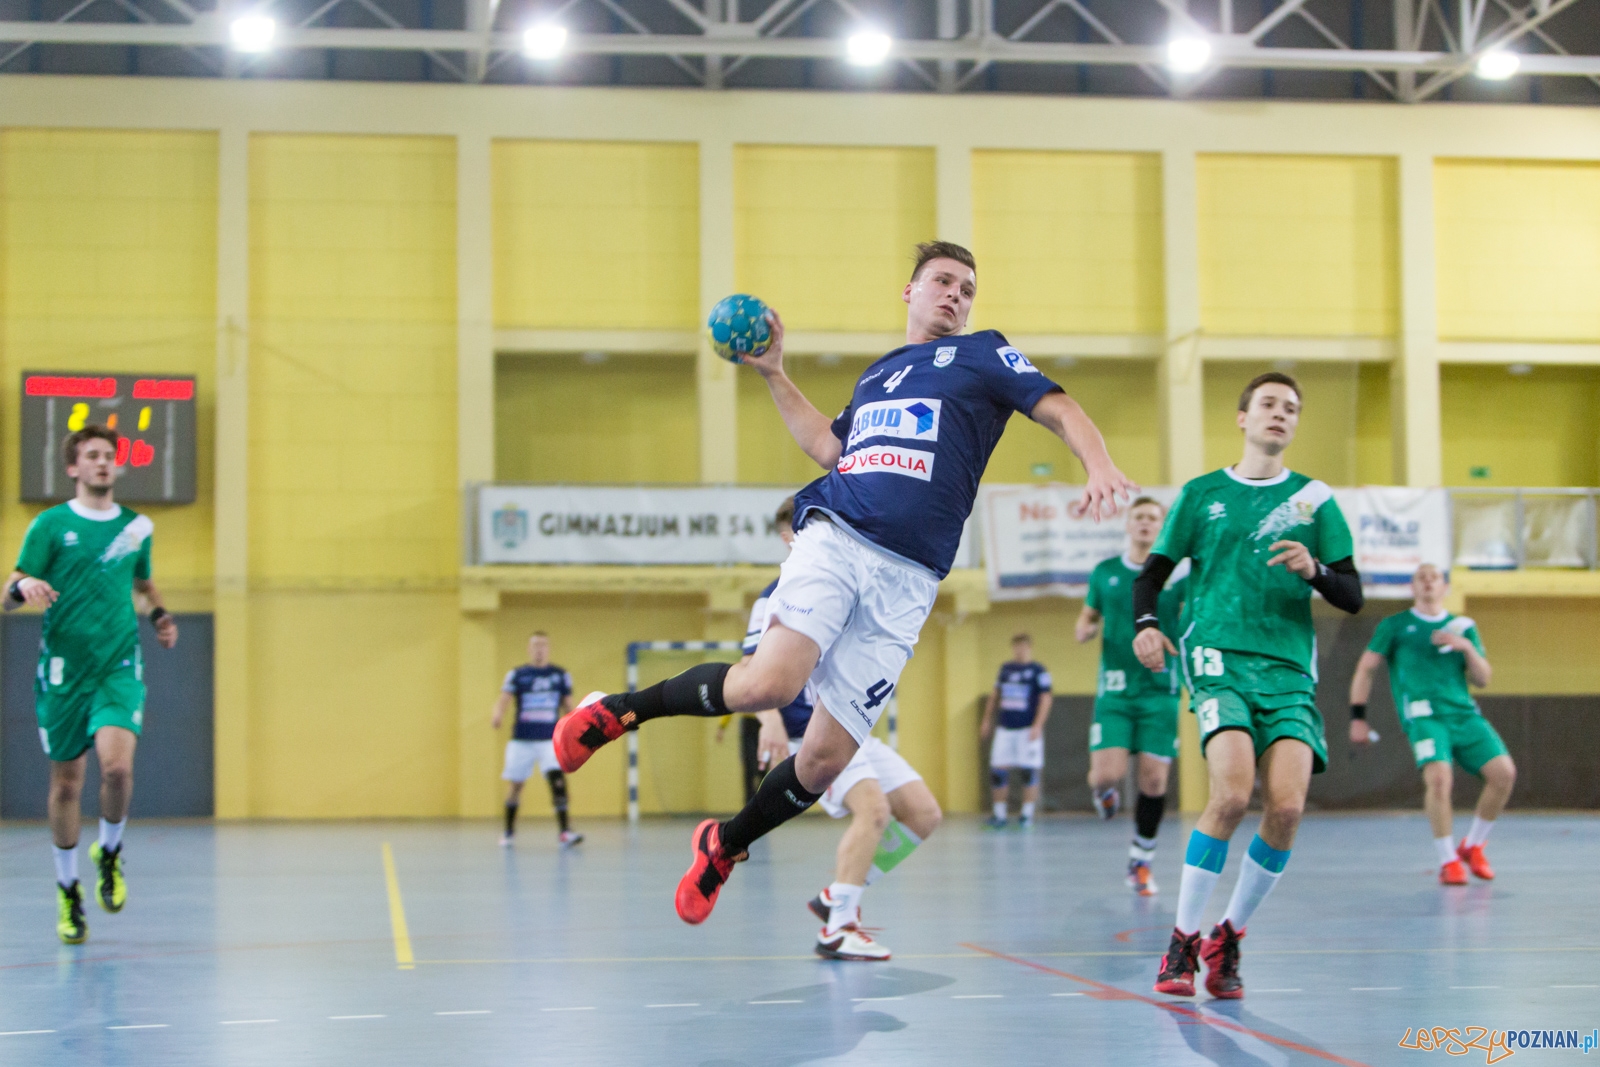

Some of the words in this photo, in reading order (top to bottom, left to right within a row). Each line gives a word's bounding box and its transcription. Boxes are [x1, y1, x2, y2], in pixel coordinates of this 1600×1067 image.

[882, 364, 914, 393] 4
[859, 452, 927, 474] VEOLIA
[539, 512, 680, 537] GIMNAZJUM
[688, 513, 719, 536] NR
[1191, 645, 1225, 676] 13
[862, 677, 895, 710] 4
